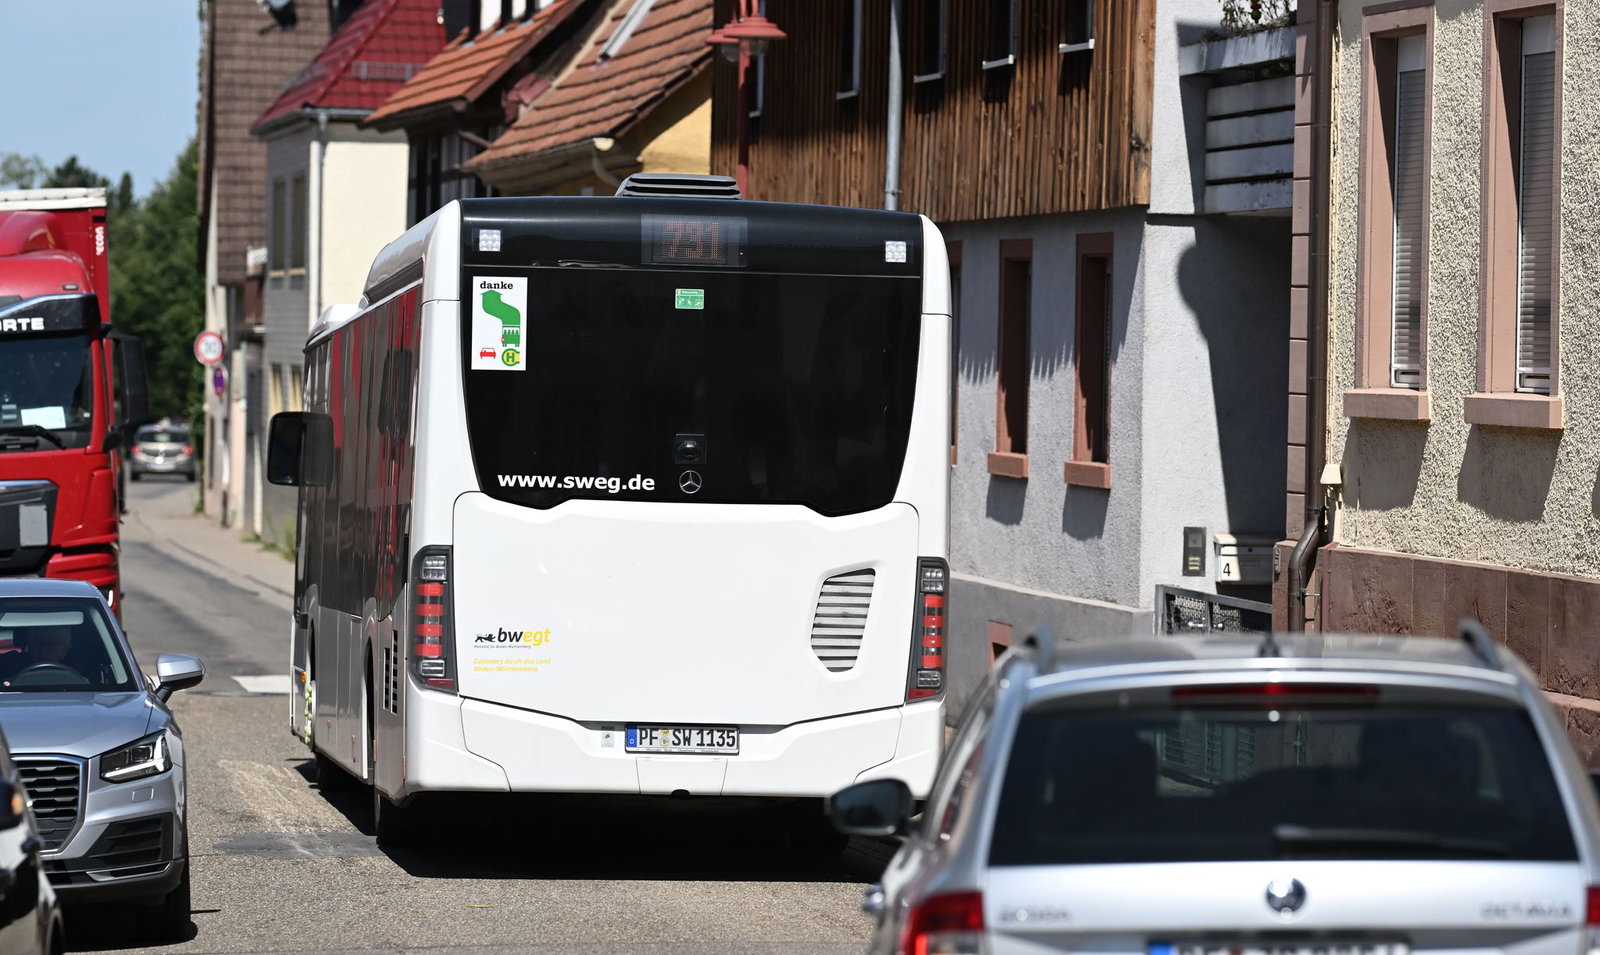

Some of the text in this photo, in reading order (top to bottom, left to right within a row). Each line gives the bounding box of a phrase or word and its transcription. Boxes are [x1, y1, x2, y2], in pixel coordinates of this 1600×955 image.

[665, 220, 719, 258] 731
[480, 281, 514, 290] danke
[0, 317, 45, 331] RTE
[497, 474, 655, 494] www.sweg.de
[1223, 563, 1231, 576] 4
[497, 627, 551, 646] bwegt
[639, 728, 658, 745] PF
[672, 728, 692, 746] SW
[696, 730, 736, 747] 1135
